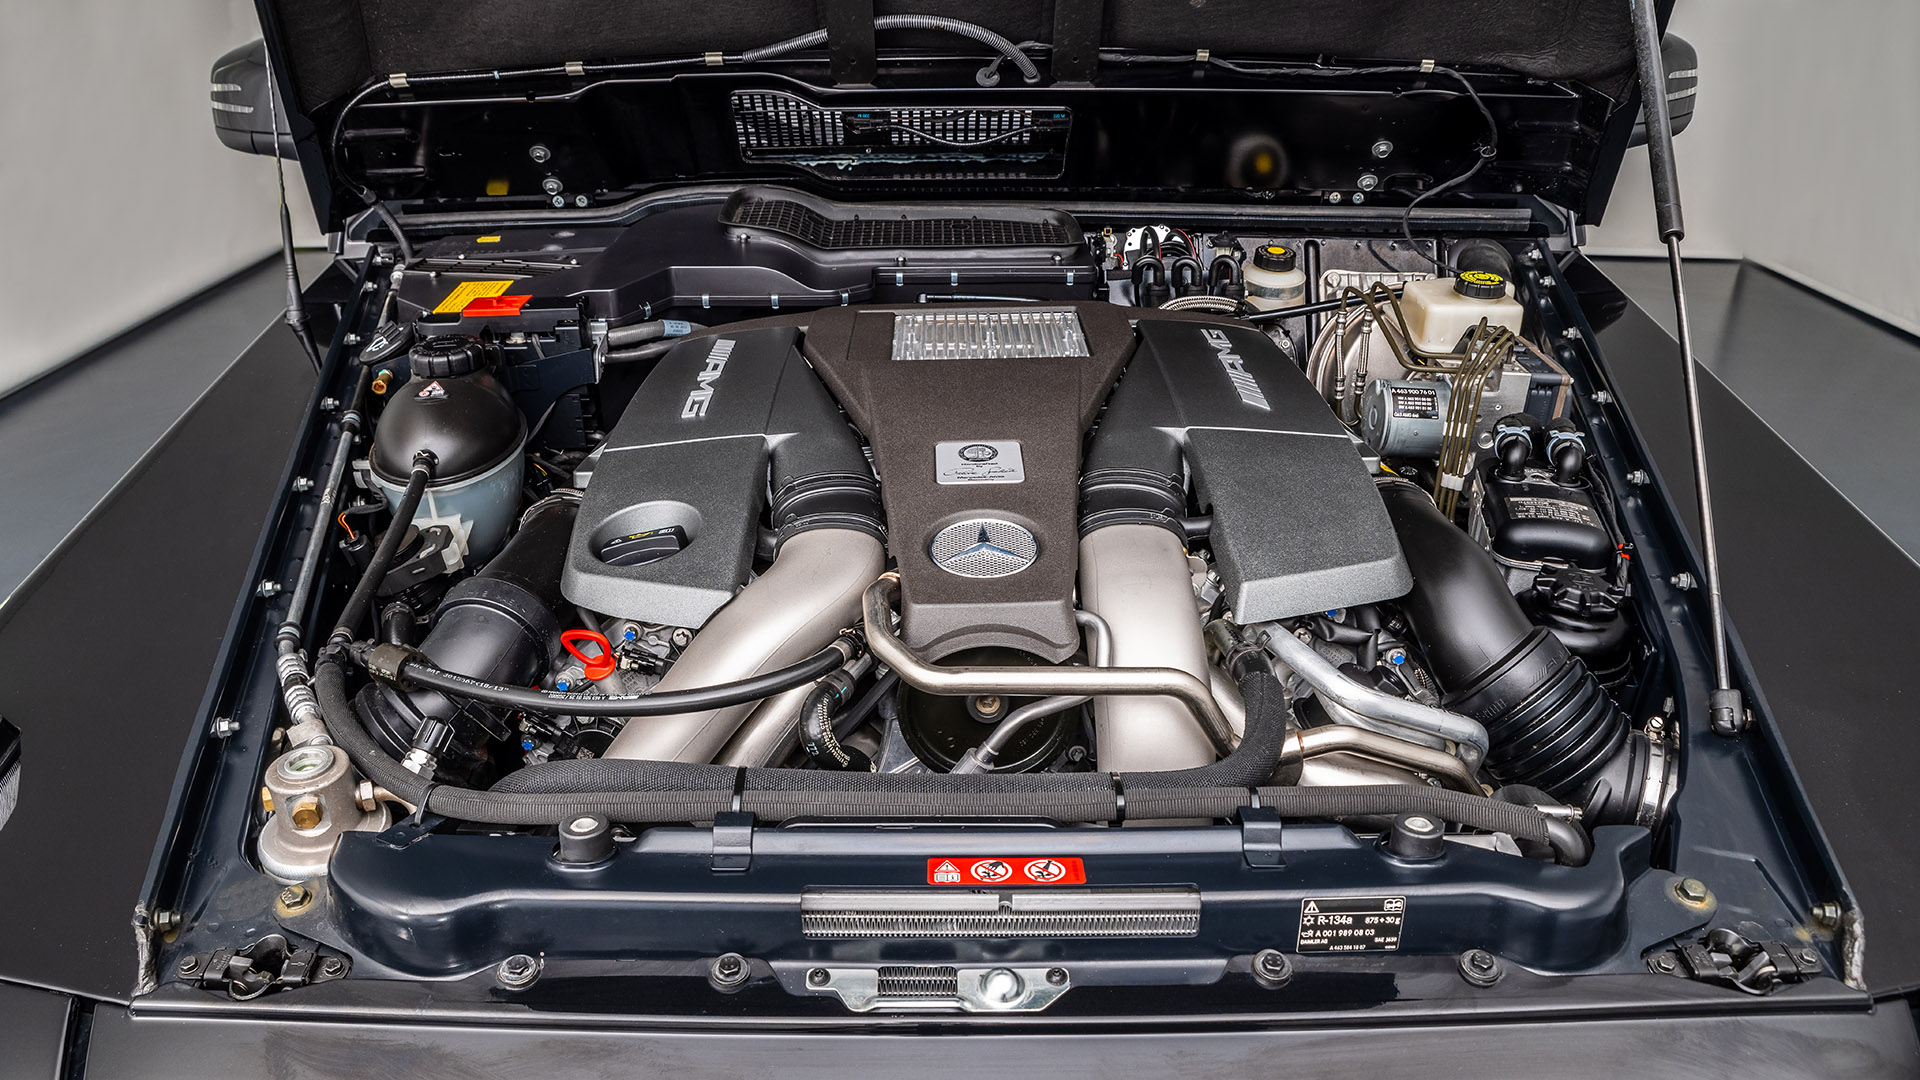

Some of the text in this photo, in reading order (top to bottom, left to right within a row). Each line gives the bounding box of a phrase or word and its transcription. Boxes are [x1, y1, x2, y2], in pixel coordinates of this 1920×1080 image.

[1200, 328, 1256, 382] AMG
[681, 354, 728, 418] AMG
[1317, 915, 1352, 925] R-134a
[1322, 929, 1336, 937] 001
[1338, 929, 1352, 937] 989
